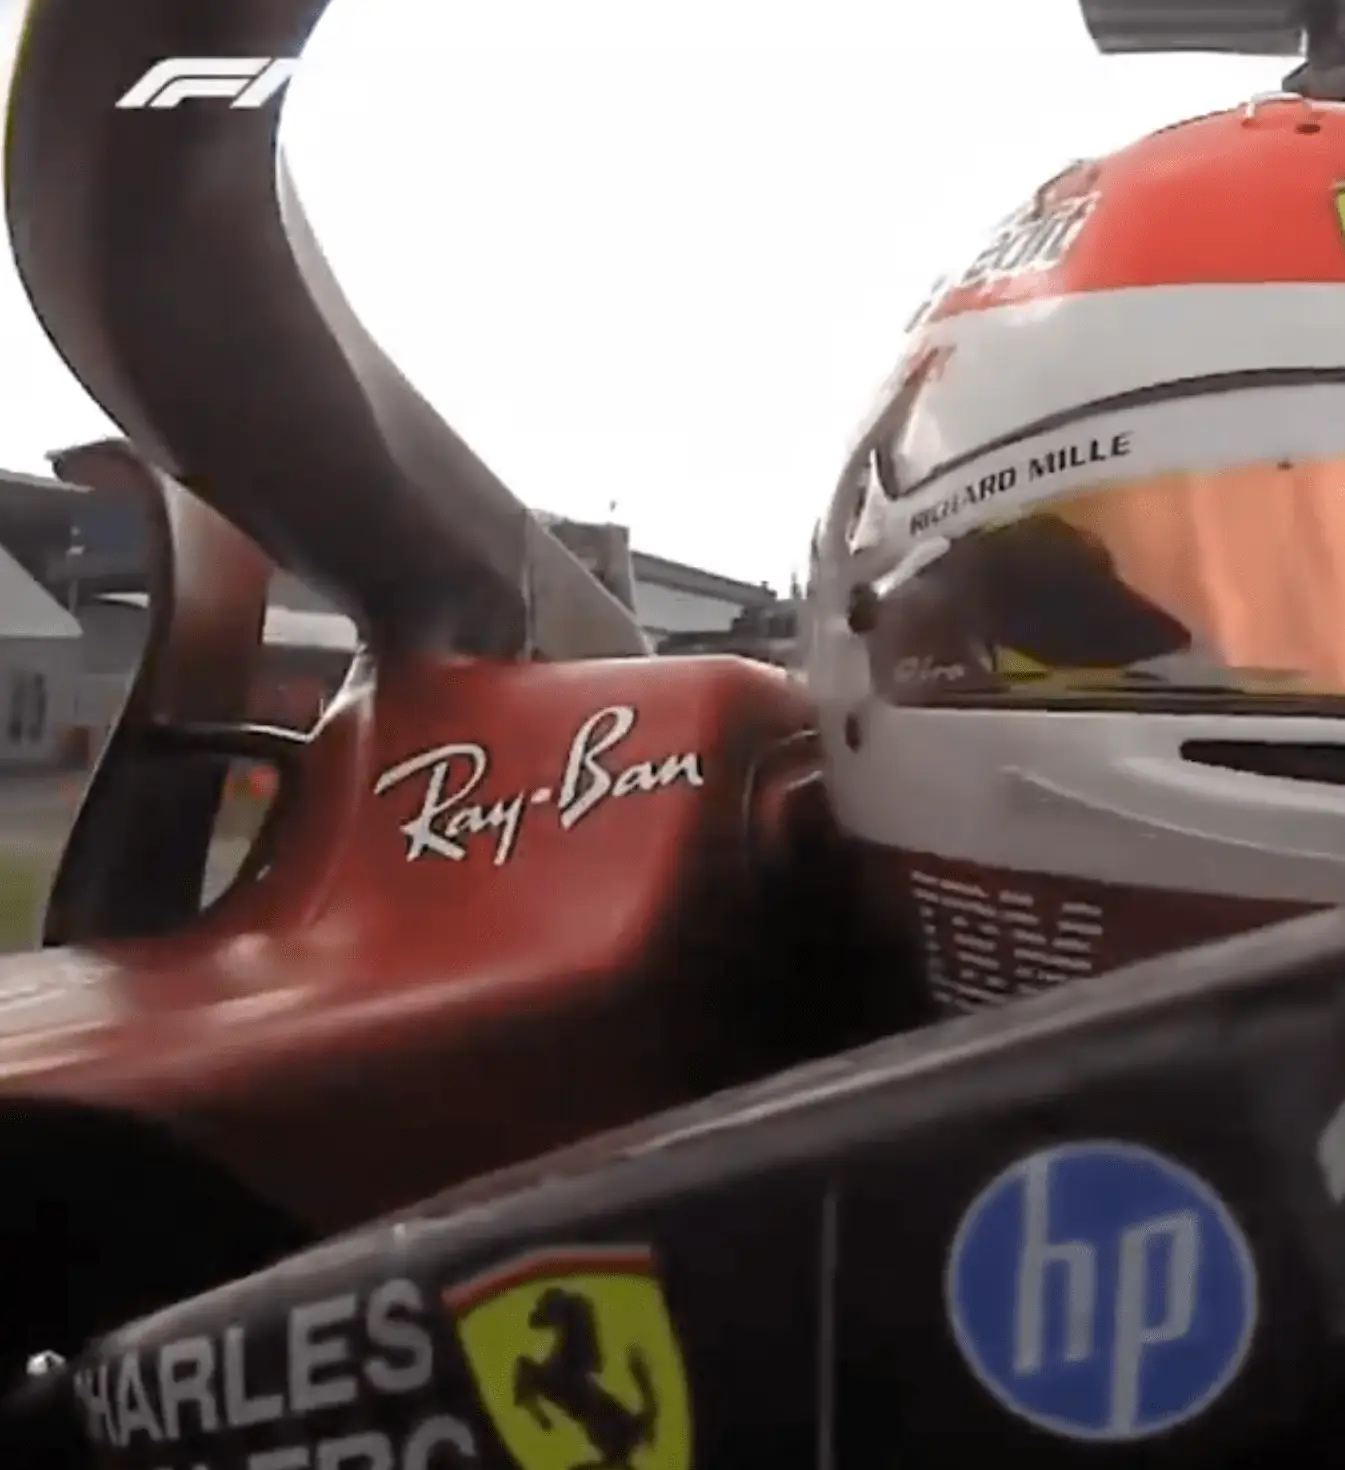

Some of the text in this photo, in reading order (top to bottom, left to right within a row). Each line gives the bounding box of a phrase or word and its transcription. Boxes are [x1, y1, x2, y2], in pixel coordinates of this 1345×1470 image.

[1028, 430, 1135, 483] MILLE
[373, 705, 704, 866] Ray-Ban
[73, 1278, 433, 1446] HARLES
